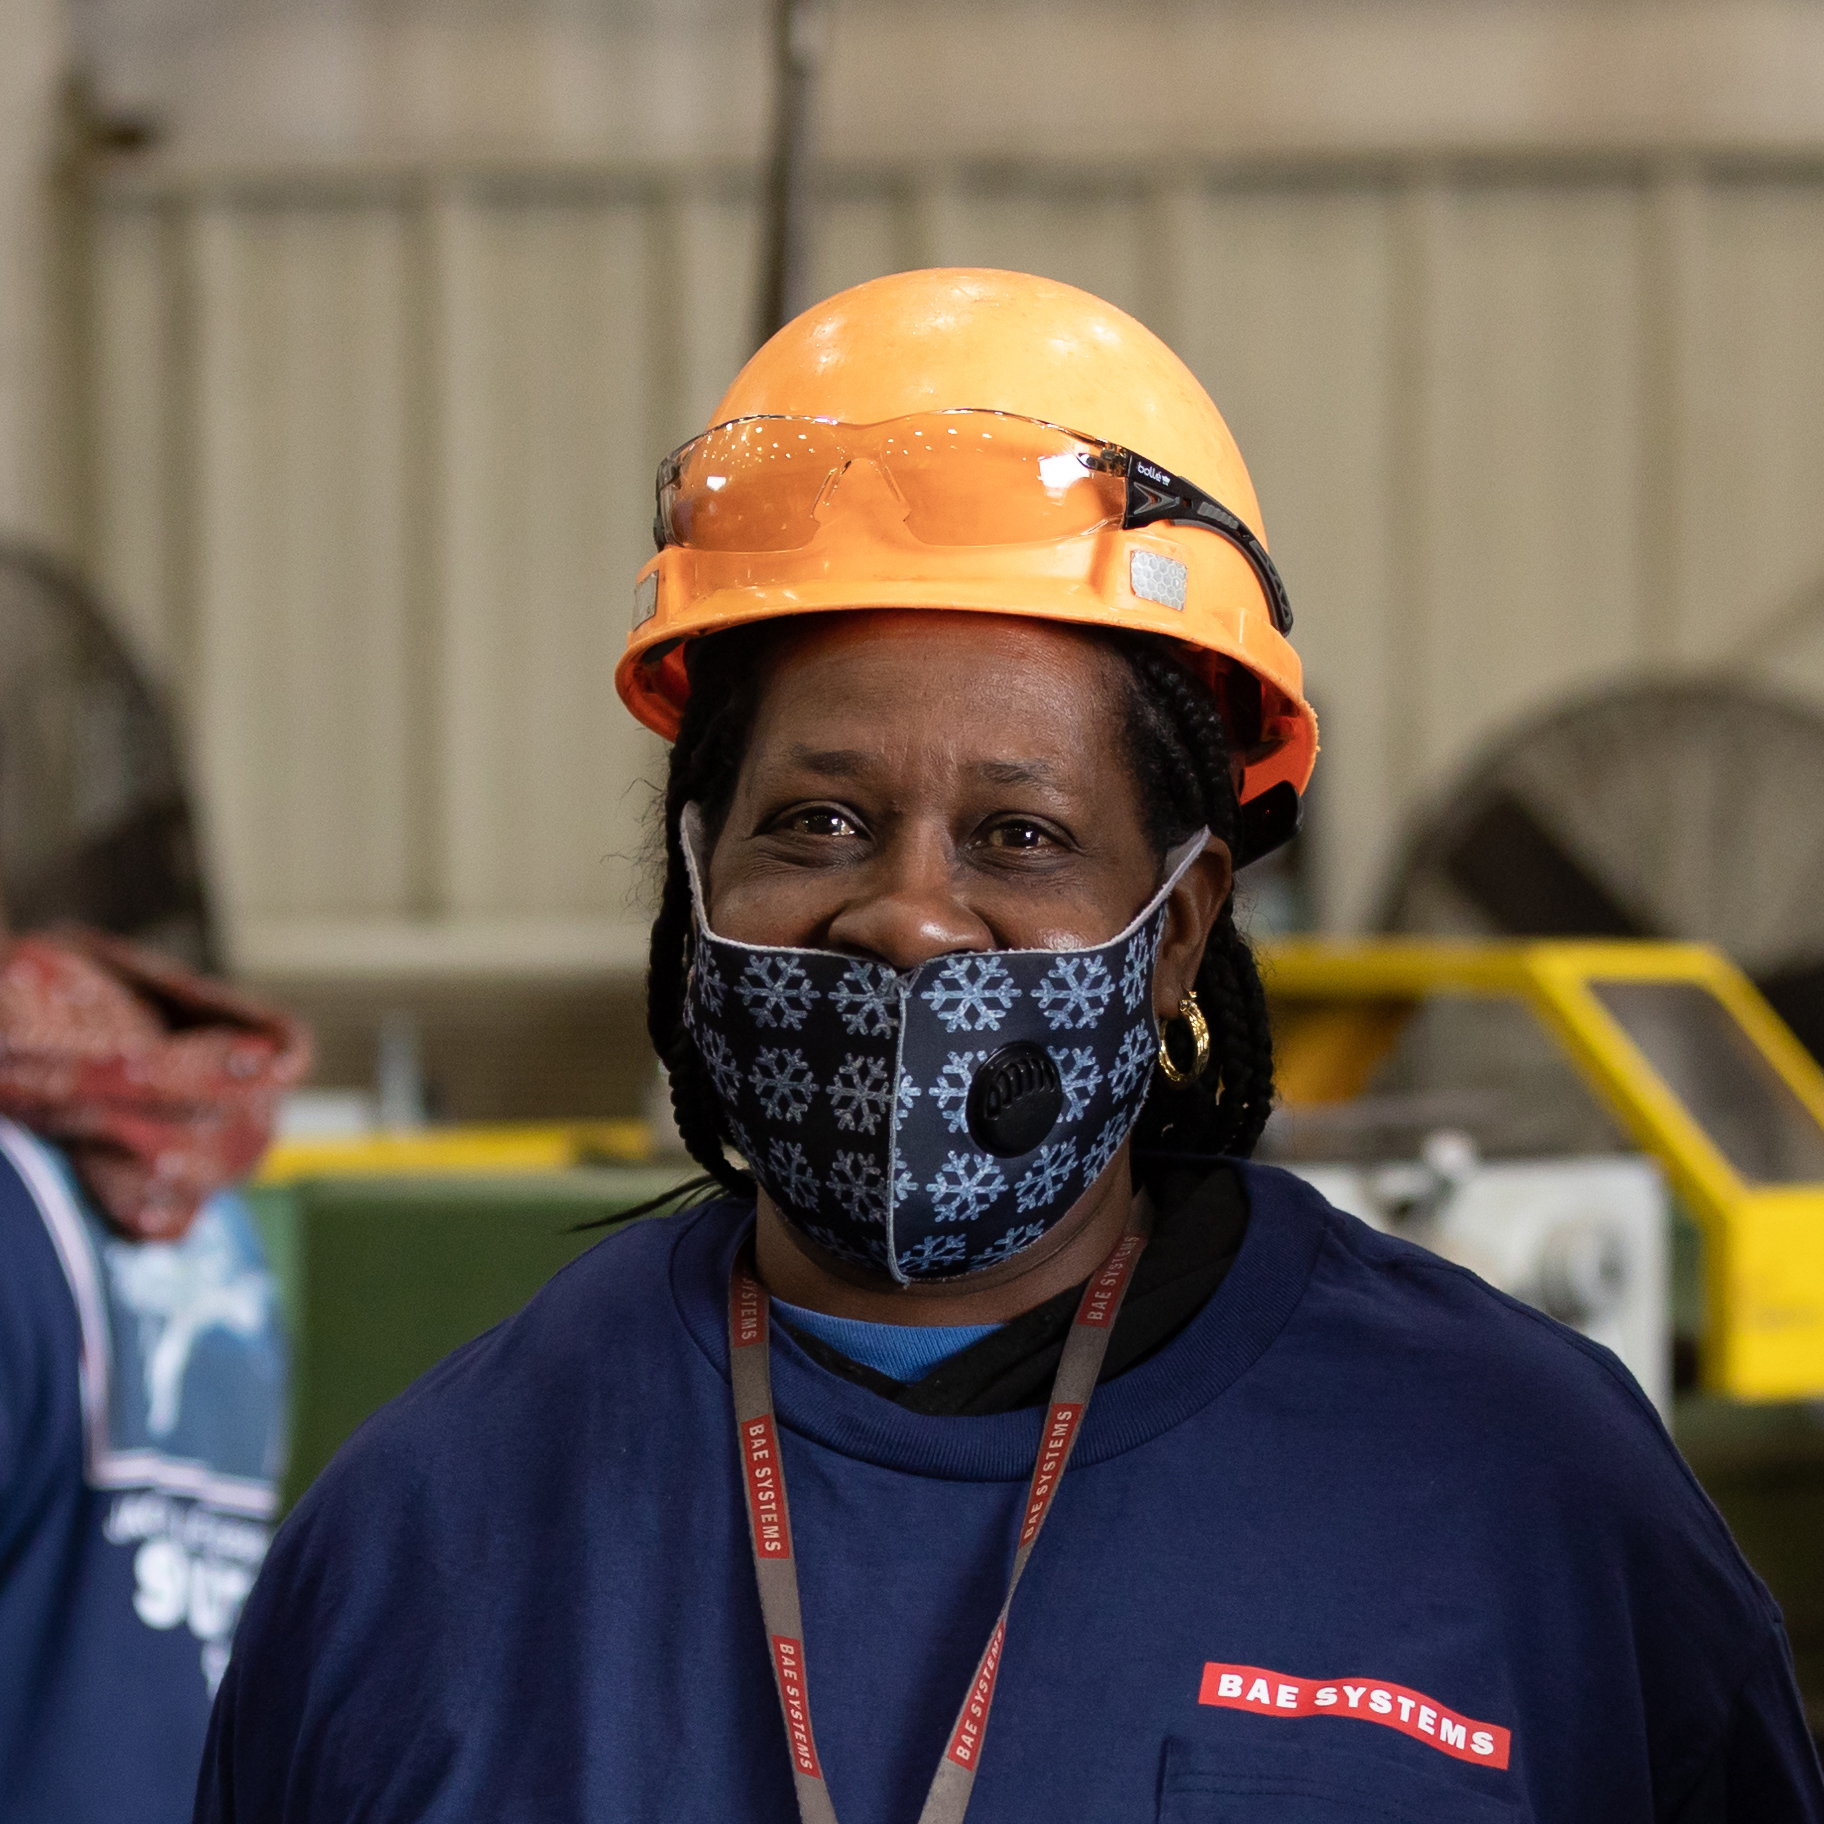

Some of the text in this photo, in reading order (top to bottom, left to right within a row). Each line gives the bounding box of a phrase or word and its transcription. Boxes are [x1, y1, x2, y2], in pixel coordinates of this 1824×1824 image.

[1137, 461, 1162, 482] bollé
[1087, 1235, 1140, 1321] BAE SYSTEMS
[749, 1423, 781, 1552] BAE SYSTEMS
[1024, 1410, 1072, 1539] BAE SYSTEMS
[779, 1643, 813, 1769] BAE SYSTEMS
[955, 1630, 1004, 1761] BAE SYSTEMS
[1217, 1673, 1494, 1755] BAE SYSTEMS
